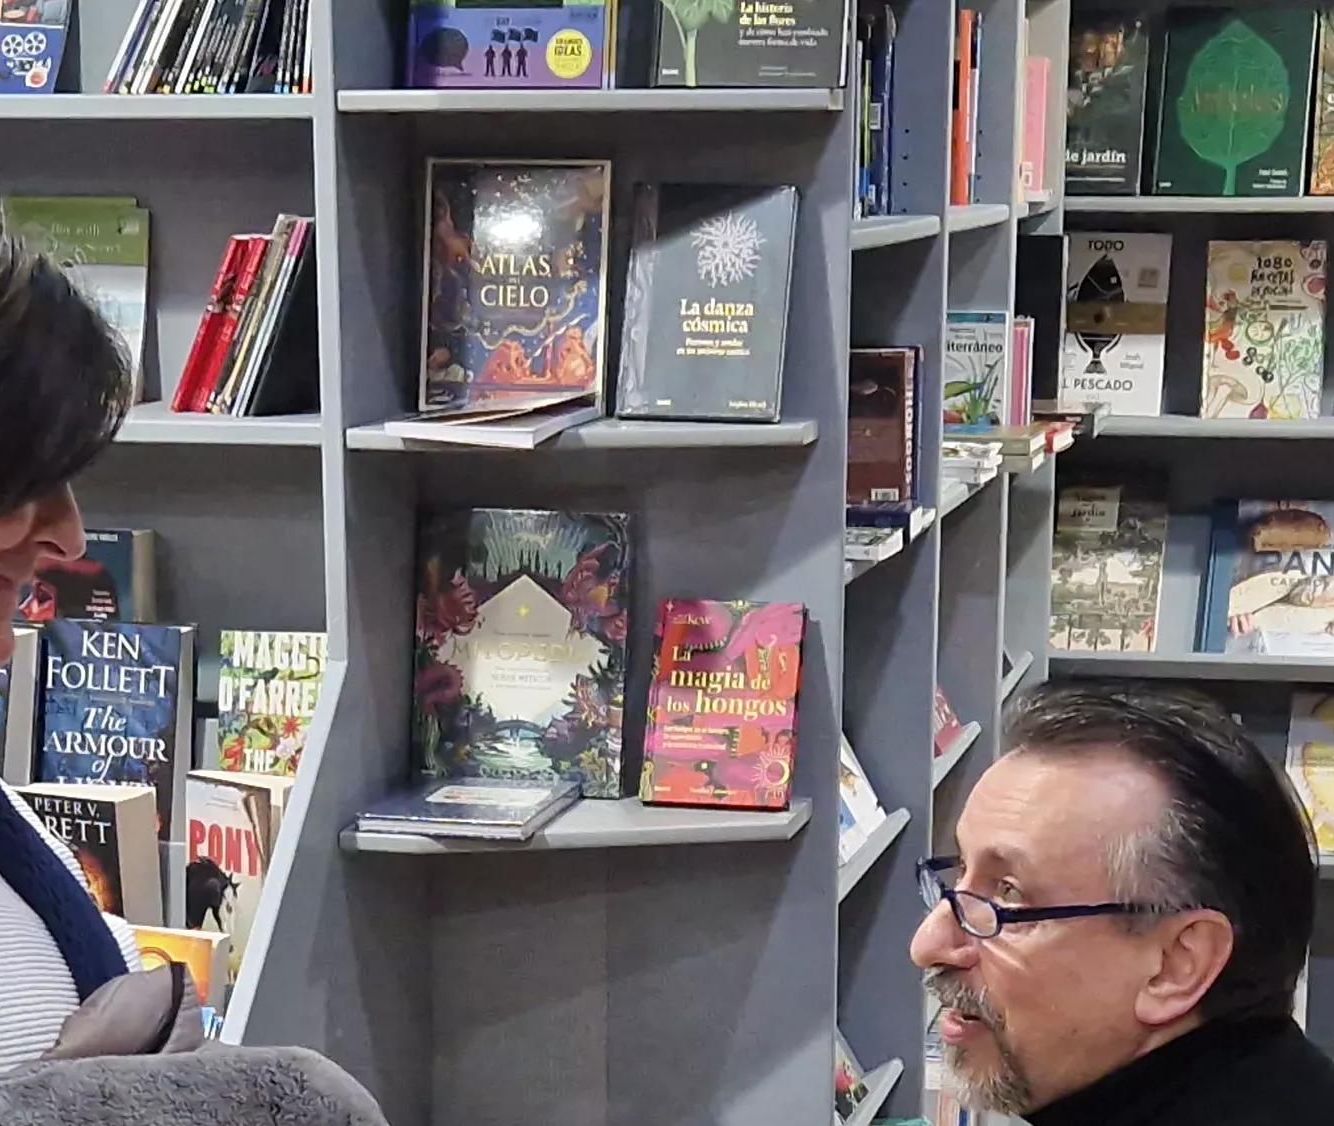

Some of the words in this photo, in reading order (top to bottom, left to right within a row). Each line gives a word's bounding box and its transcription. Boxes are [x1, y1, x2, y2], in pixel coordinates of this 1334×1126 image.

[1081, 148, 1126, 166] jardín
[481, 254, 551, 277] ATLAS
[1257, 257, 1293, 268] 1080
[480, 284, 549, 308] CIELO
[680, 298, 700, 316] La
[704, 298, 754, 316] danza
[682, 316, 748, 333] cósmica
[946, 340, 1004, 353] iterráneo
[1073, 377, 1133, 391] PESCADO
[81, 630, 140, 660] KEN
[233, 632, 328, 671] MAGGI
[672, 646, 692, 662] La
[45, 655, 175, 698] FOLLETT
[670, 665, 745, 693] magia
[751, 676, 771, 691] de
[219, 676, 322, 715] O'FARRE
[667, 696, 690, 713] los
[694, 690, 788, 721] hongos
[83, 704, 126, 732] The
[43, 731, 169, 763] ARMOUR
[91, 753, 114, 782] of
[244, 749, 275, 772] THE
[35, 797, 81, 815] PETER
[87, 803, 100, 817] V.
[44, 815, 112, 844] RETT
[189, 819, 258, 877] PONY
